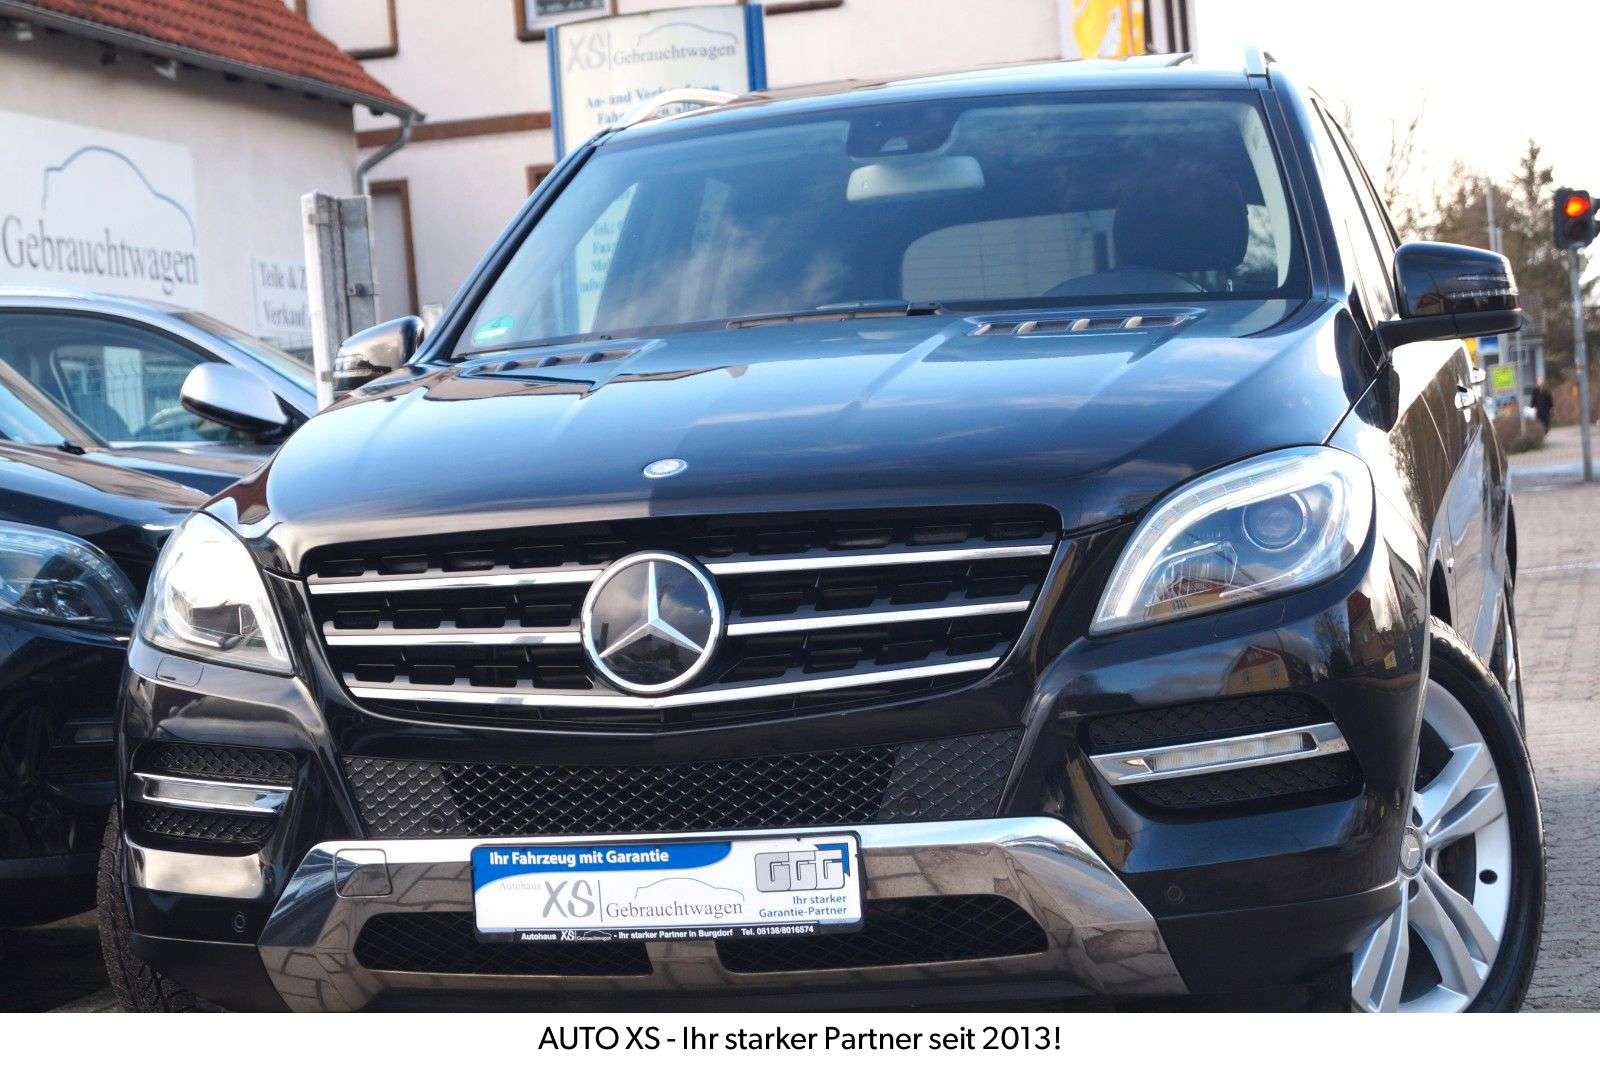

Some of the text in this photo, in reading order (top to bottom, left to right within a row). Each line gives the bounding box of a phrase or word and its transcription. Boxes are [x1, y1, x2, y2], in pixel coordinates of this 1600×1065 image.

[613, 44, 737, 65] Gebrauchtwagen
[2, 215, 198, 296] Gebrauchtwagen
[489, 849, 670, 867] Ihr Fahrzeug mit Garantie
[500, 880, 743, 919] Autohaus XS Gebrauchtwagen
[793, 894, 847, 905] Ihr starker
[759, 906, 847, 918] Garantie-Partner
[521, 932, 557, 940] Autohaus
[631, 931, 657, 939] starker
[659, 930, 687, 938] Partner
[698, 929, 733, 939] Burgdorf
